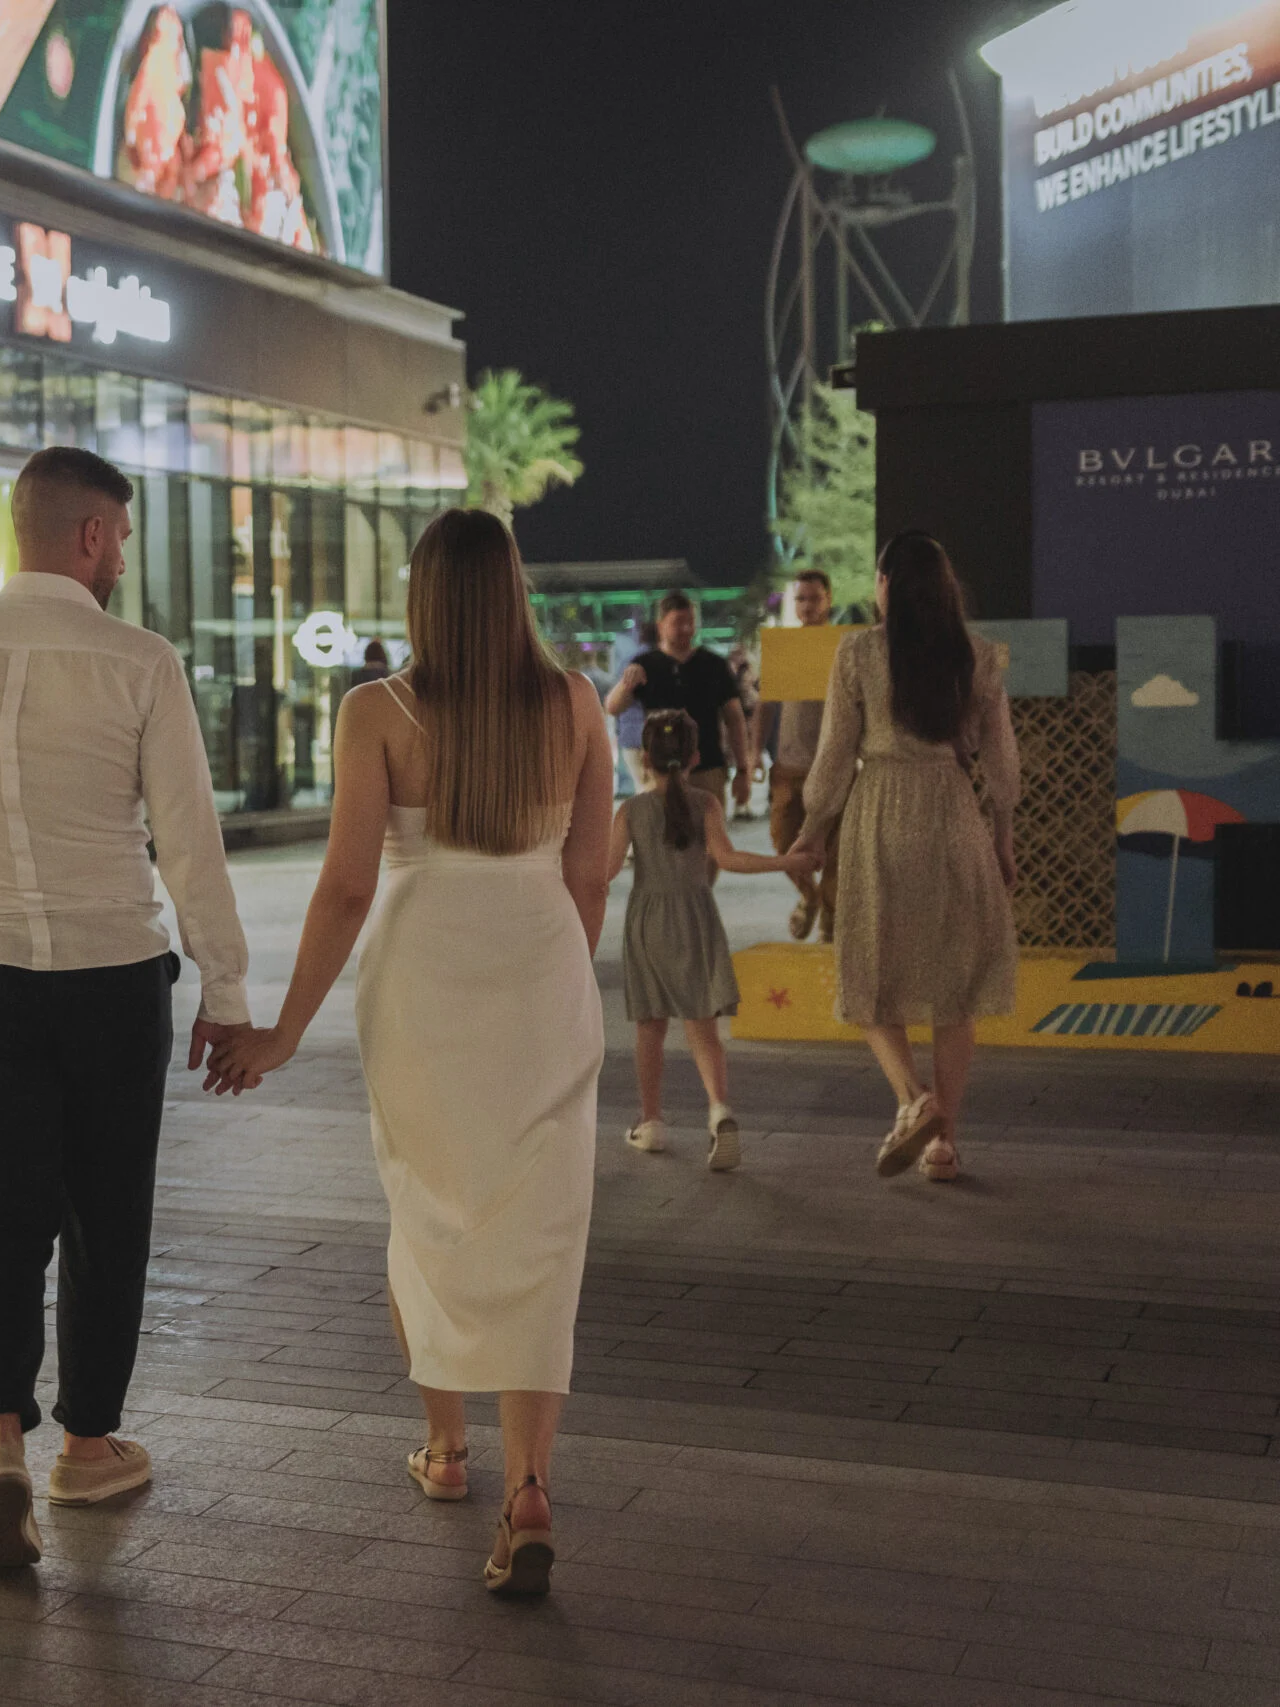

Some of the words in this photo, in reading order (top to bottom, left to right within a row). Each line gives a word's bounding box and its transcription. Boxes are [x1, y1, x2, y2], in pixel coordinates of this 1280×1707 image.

[1035, 111, 1094, 167] BUILD
[1035, 168, 1069, 213] WE
[1070, 129, 1168, 201] ENHANCE
[1075, 473, 1145, 488] RESORT
